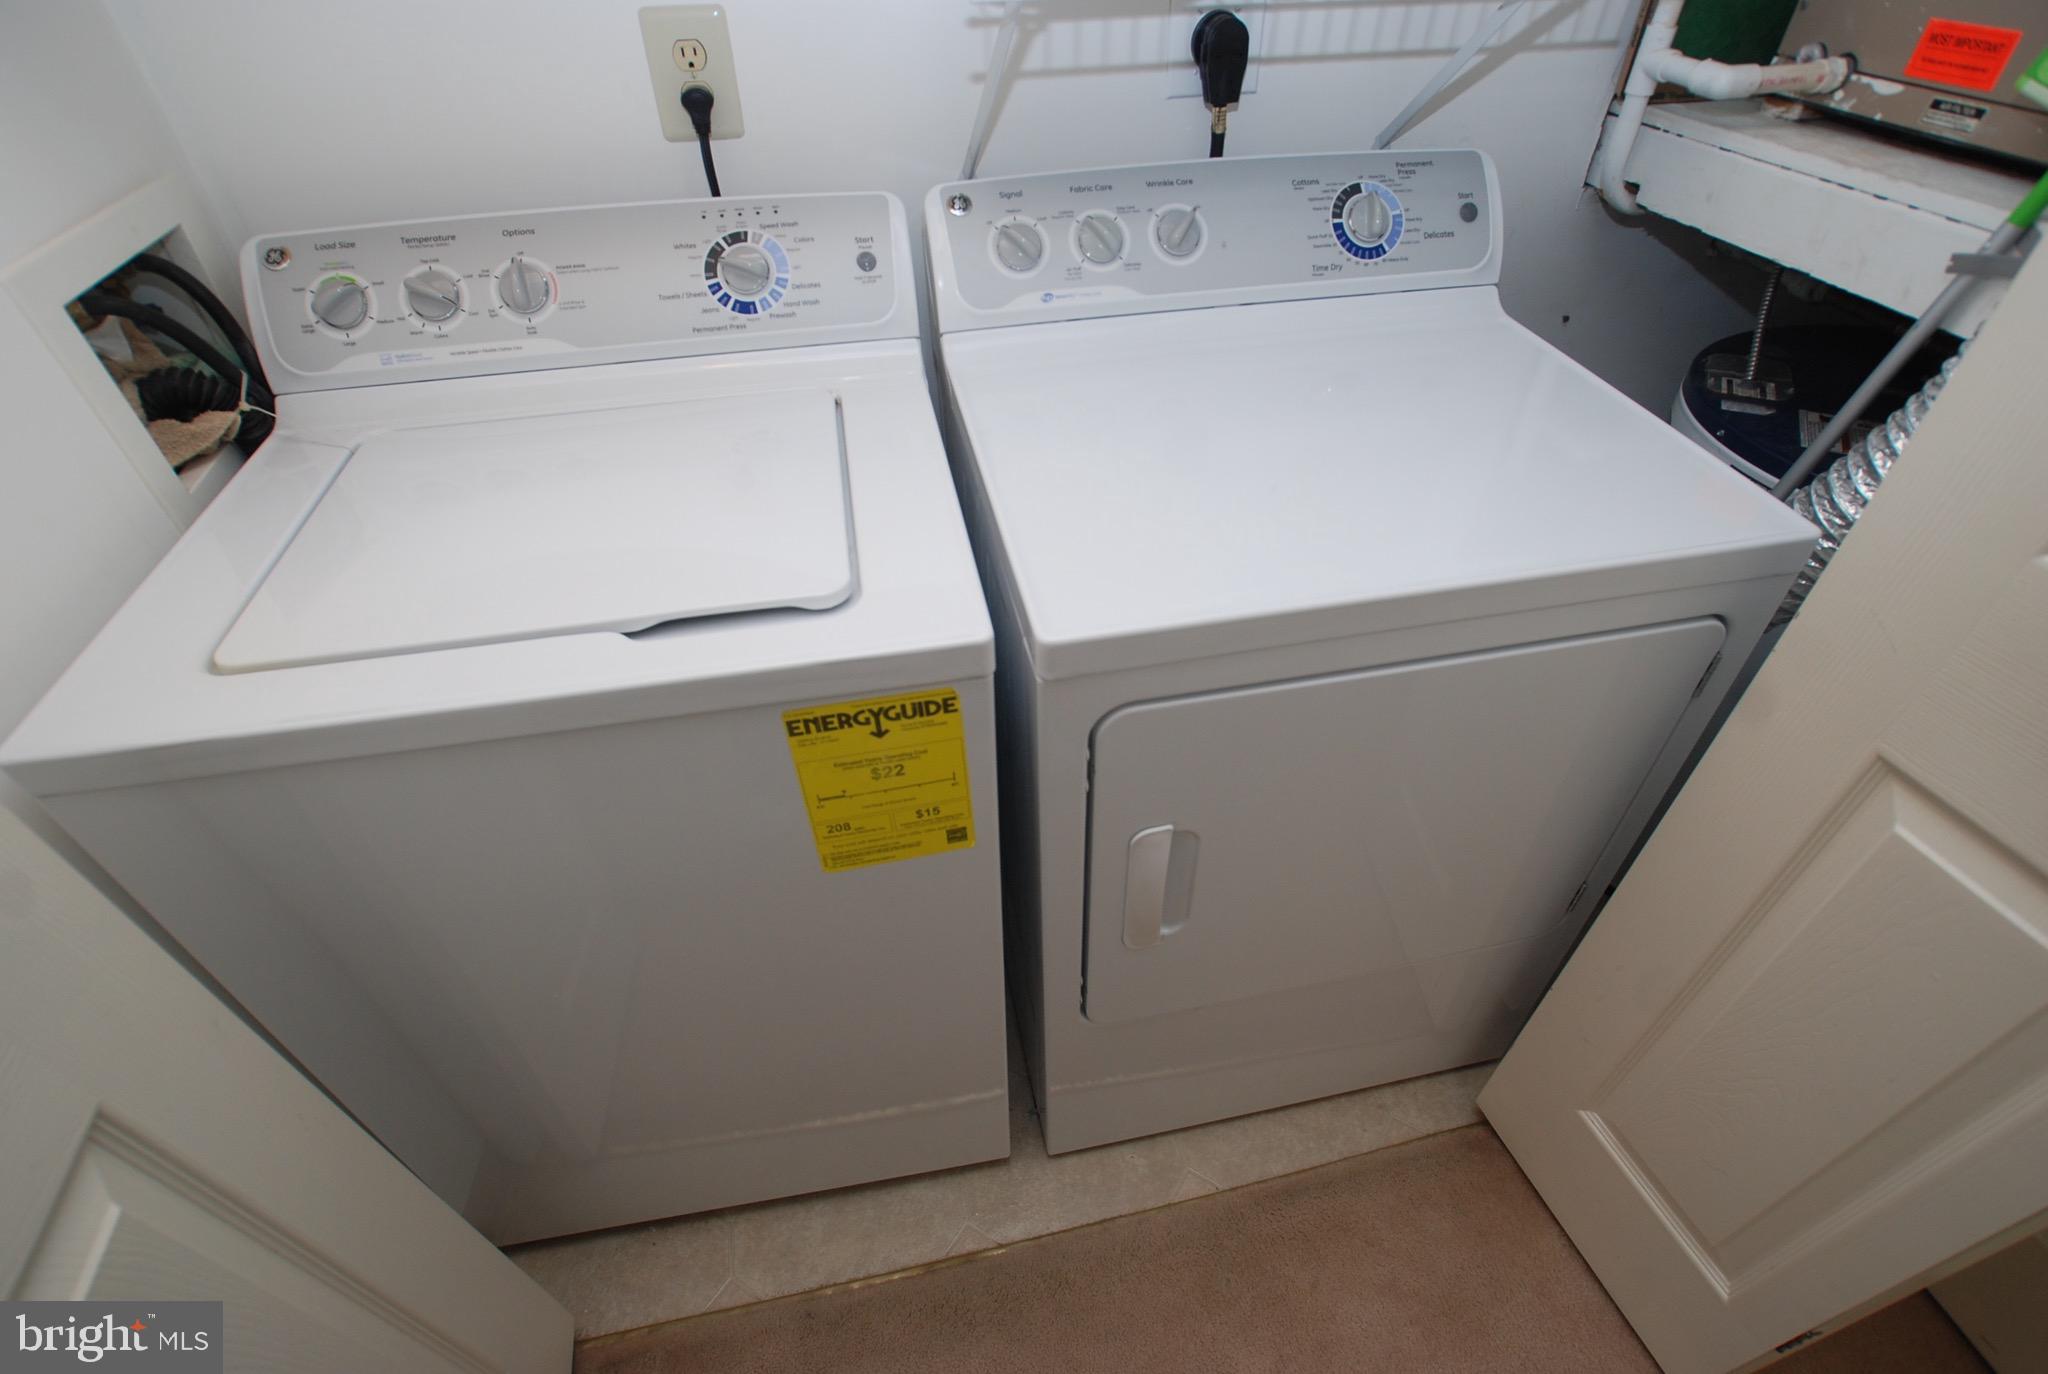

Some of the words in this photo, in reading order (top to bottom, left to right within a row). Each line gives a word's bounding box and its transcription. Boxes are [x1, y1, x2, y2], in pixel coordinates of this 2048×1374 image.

[1145, 179, 1175, 188] Wrinkle
[1176, 178, 1194, 186] Care
[1291, 178, 1320, 186] Cottons
[1069, 185, 1093, 194] Fabric
[1095, 183, 1113, 192] Care
[999, 190, 1023, 200] Signal
[502, 228, 536, 237] Options
[1424, 231, 1455, 239] Delicates
[400, 234, 456, 244] Temperature
[855, 236, 874, 244] Start
[314, 242, 337, 251] Load
[338, 241, 356, 249] Size
[674, 242, 697, 250] Whites
[1312, 264, 1329, 272] Time
[1330, 263, 1343, 271] Dry
[791, 282, 821, 290] Delicates
[686, 291, 707, 299] Sheets
[769, 311, 797, 319] Prewash
[692, 325, 728, 334] Permanent
[729, 323, 747, 331] Press
[786, 696, 958, 738] ENERGYGUIDE
[870, 763, 906, 781] $22
[915, 806, 941, 819] $15
[826, 822, 852, 834] 208
